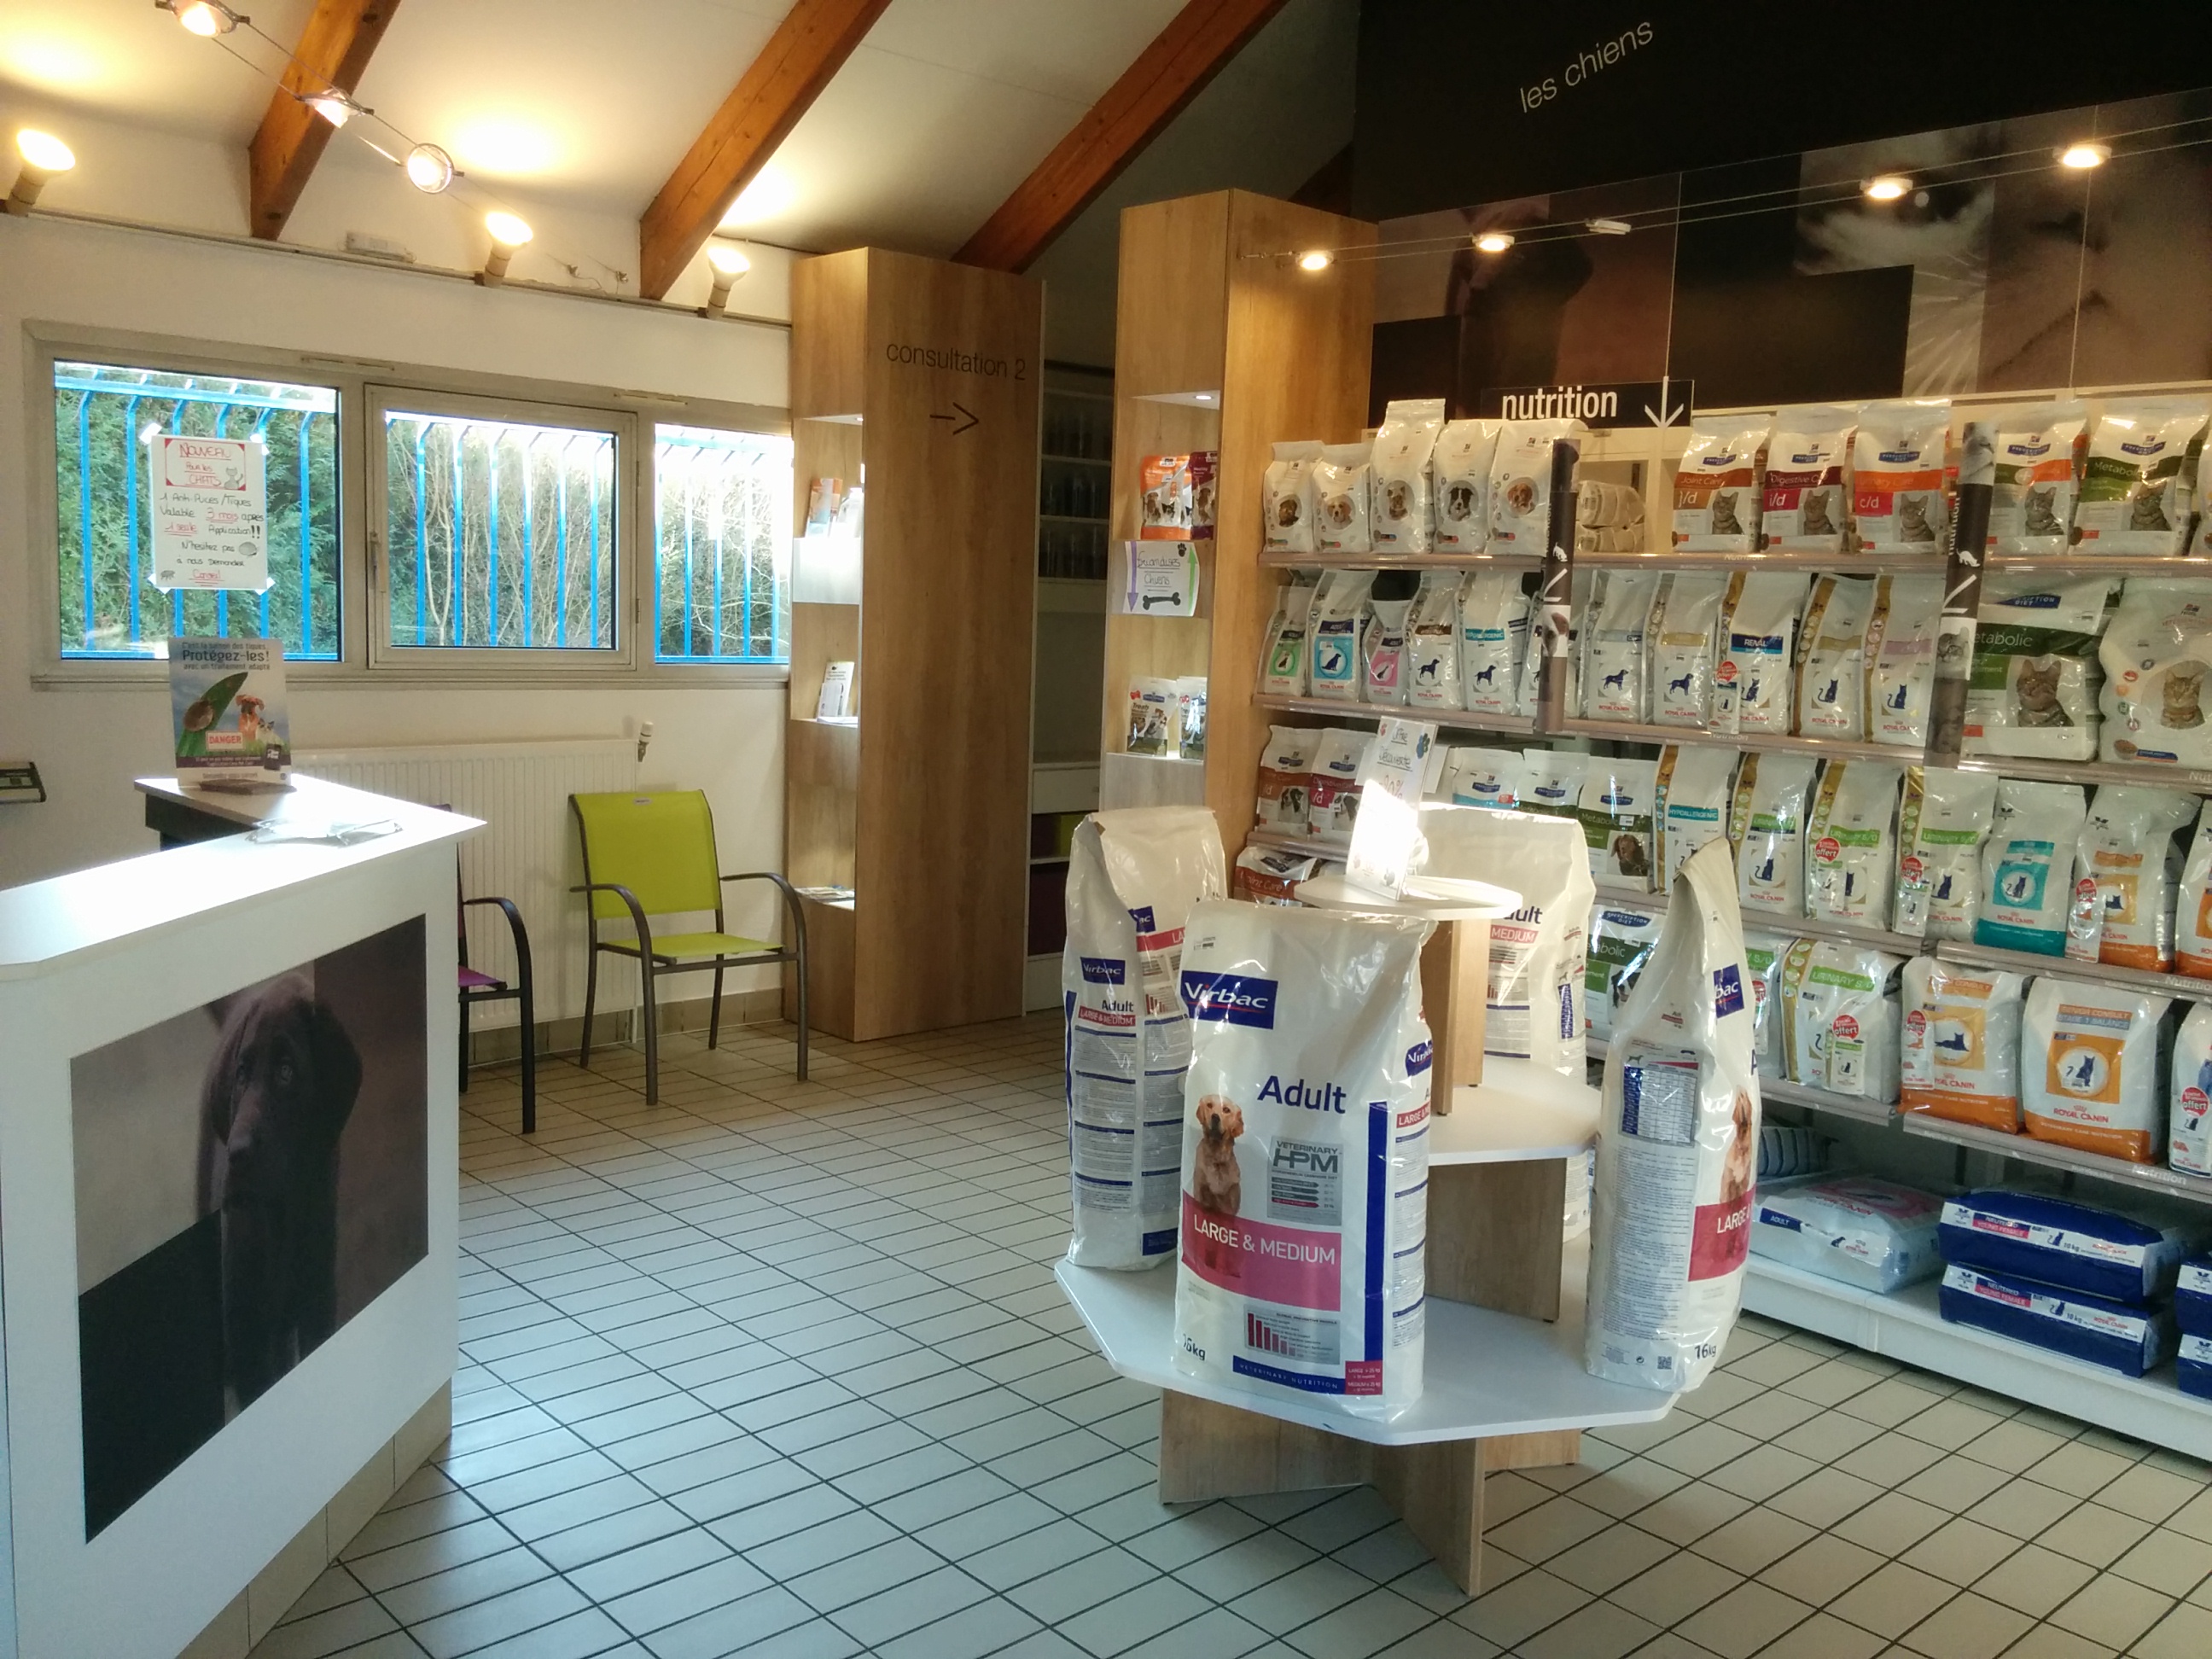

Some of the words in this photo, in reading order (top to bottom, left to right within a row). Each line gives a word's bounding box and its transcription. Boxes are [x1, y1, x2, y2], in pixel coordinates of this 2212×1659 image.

[1519, 79, 1558, 114] les
[1564, 21, 1655, 86] chiens
[886, 343, 1007, 378] consultation
[1014, 358, 1027, 381] 2
[1501, 385, 1618, 420] nutrition
[179, 443, 231, 458] NOUVEAU
[1860, 496, 1879, 509] c/d
[160, 506, 196, 518] Valable
[1743, 638, 1767, 647] RENAL
[1973, 631, 2033, 648] etabolic
[208, 735, 242, 745] DANGER
[1491, 927, 1536, 943] MEDIUM
[1082, 963, 1123, 975] Virbac
[1185, 981, 1269, 1010] Virbac
[1101, 999, 1134, 1013] Adult
[1080, 1009, 1098, 1022] LARGE
[1835, 1026, 1858, 1035] offert
[1257, 1075, 1347, 1114] Adult
[2183, 1101, 2207, 1110] offert
[2053, 1107, 2079, 1119] ROYAL
[2081, 1112, 2109, 1123] CANIN
[1277, 1140, 1338, 1155] VETERINARY
[1272, 1147, 1338, 1173] HPM
[2133, 1164, 2187, 1185] Nutrition
[1717, 1211, 1747, 1235] LARGE
[1770, 1215, 1790, 1225] ADULT
[1193, 1214, 1239, 1249] LARGE
[1242, 1234, 1255, 1253] &
[1260, 1240, 1336, 1265] MEDIUM
[1694, 1343, 1717, 1359] 16kg
[1239, 1364, 1287, 1380] VETERINARY
[1291, 1377, 1338, 1390] NUTRITION
